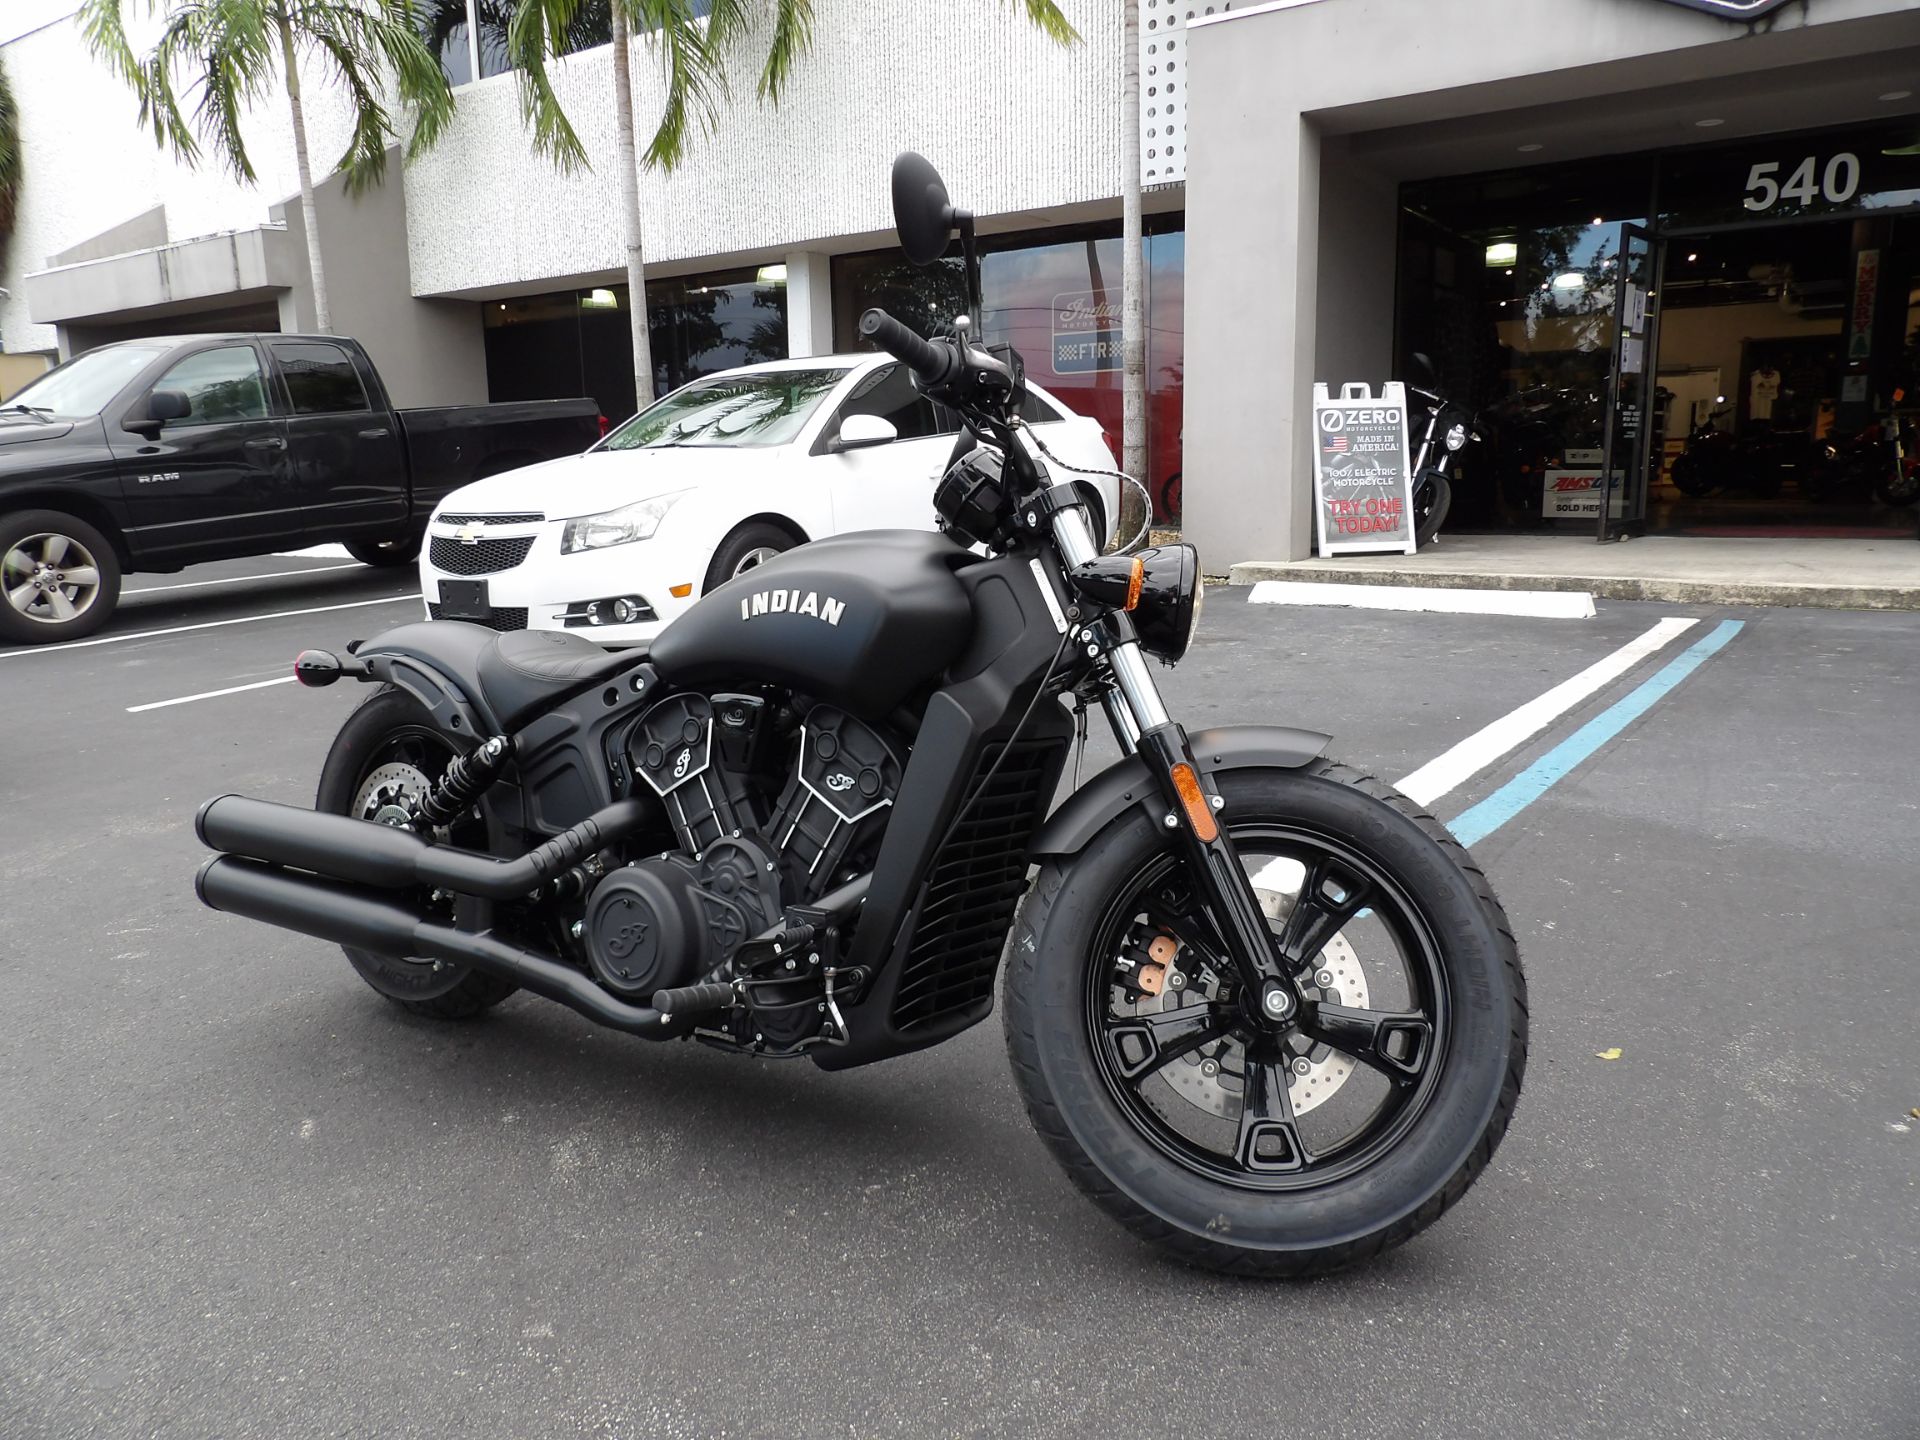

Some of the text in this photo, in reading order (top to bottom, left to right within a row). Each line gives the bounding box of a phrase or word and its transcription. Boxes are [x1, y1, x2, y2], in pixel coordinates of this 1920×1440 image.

[1743, 152, 1860, 211] 540
[1855, 265, 1876, 334] MERRY
[1079, 341, 1107, 360] FTR
[1345, 409, 1400, 424] ZERO
[1357, 435, 1394, 443] MADE IN
[1352, 443, 1399, 452] AMERICA!
[138, 472, 180, 484] RAM
[1329, 468, 1397, 478] 100% ELECTRIC
[1333, 477, 1394, 487] MOTORCYCLE
[1328, 497, 1403, 517] TRY ONE
[1556, 504, 1580, 512] SOLD
[1335, 516, 1399, 534] TODAY!
[741, 589, 847, 627] INDIAN
[377, 964, 426, 990] NIGHT
